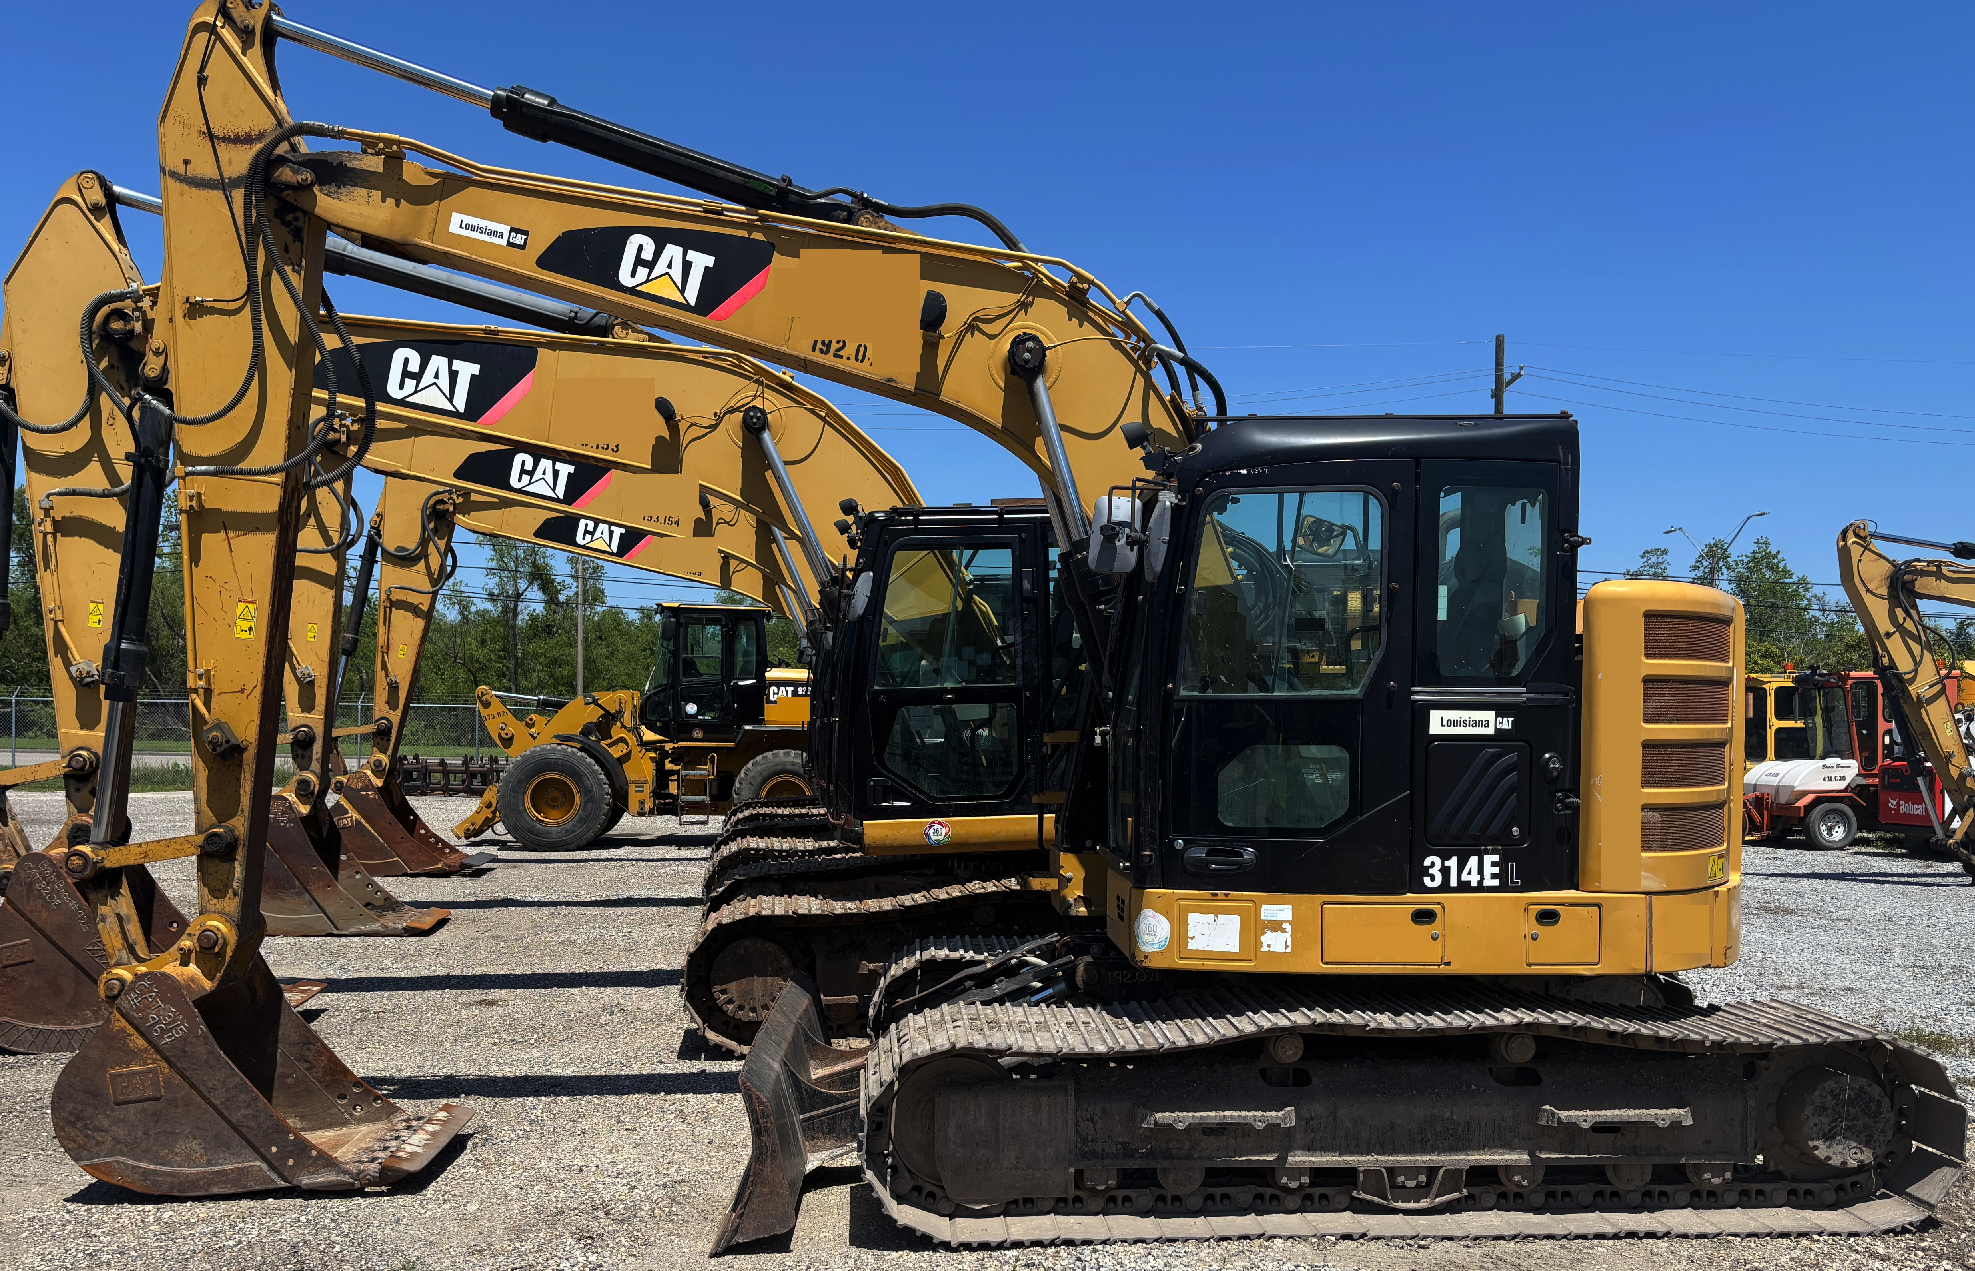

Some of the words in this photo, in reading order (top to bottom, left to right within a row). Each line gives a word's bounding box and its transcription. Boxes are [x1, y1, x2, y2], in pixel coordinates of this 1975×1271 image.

[459, 219, 504, 239] Louisiana
[509, 232, 527, 245] CAT
[618, 233, 715, 306] CAT
[386, 347, 481, 413] CAT
[509, 452, 575, 499] CAT
[575, 518, 625, 553] CAT
[769, 686, 794, 701] CAT
[1440, 716, 1490, 729] Louisiana
[1496, 717, 1514, 729] CAT
[1900, 801, 1926, 816] Bobcat
[1423, 855, 1500, 888] 314E
[1508, 862, 1521, 886] L
[1143, 922, 1157, 933] 360
